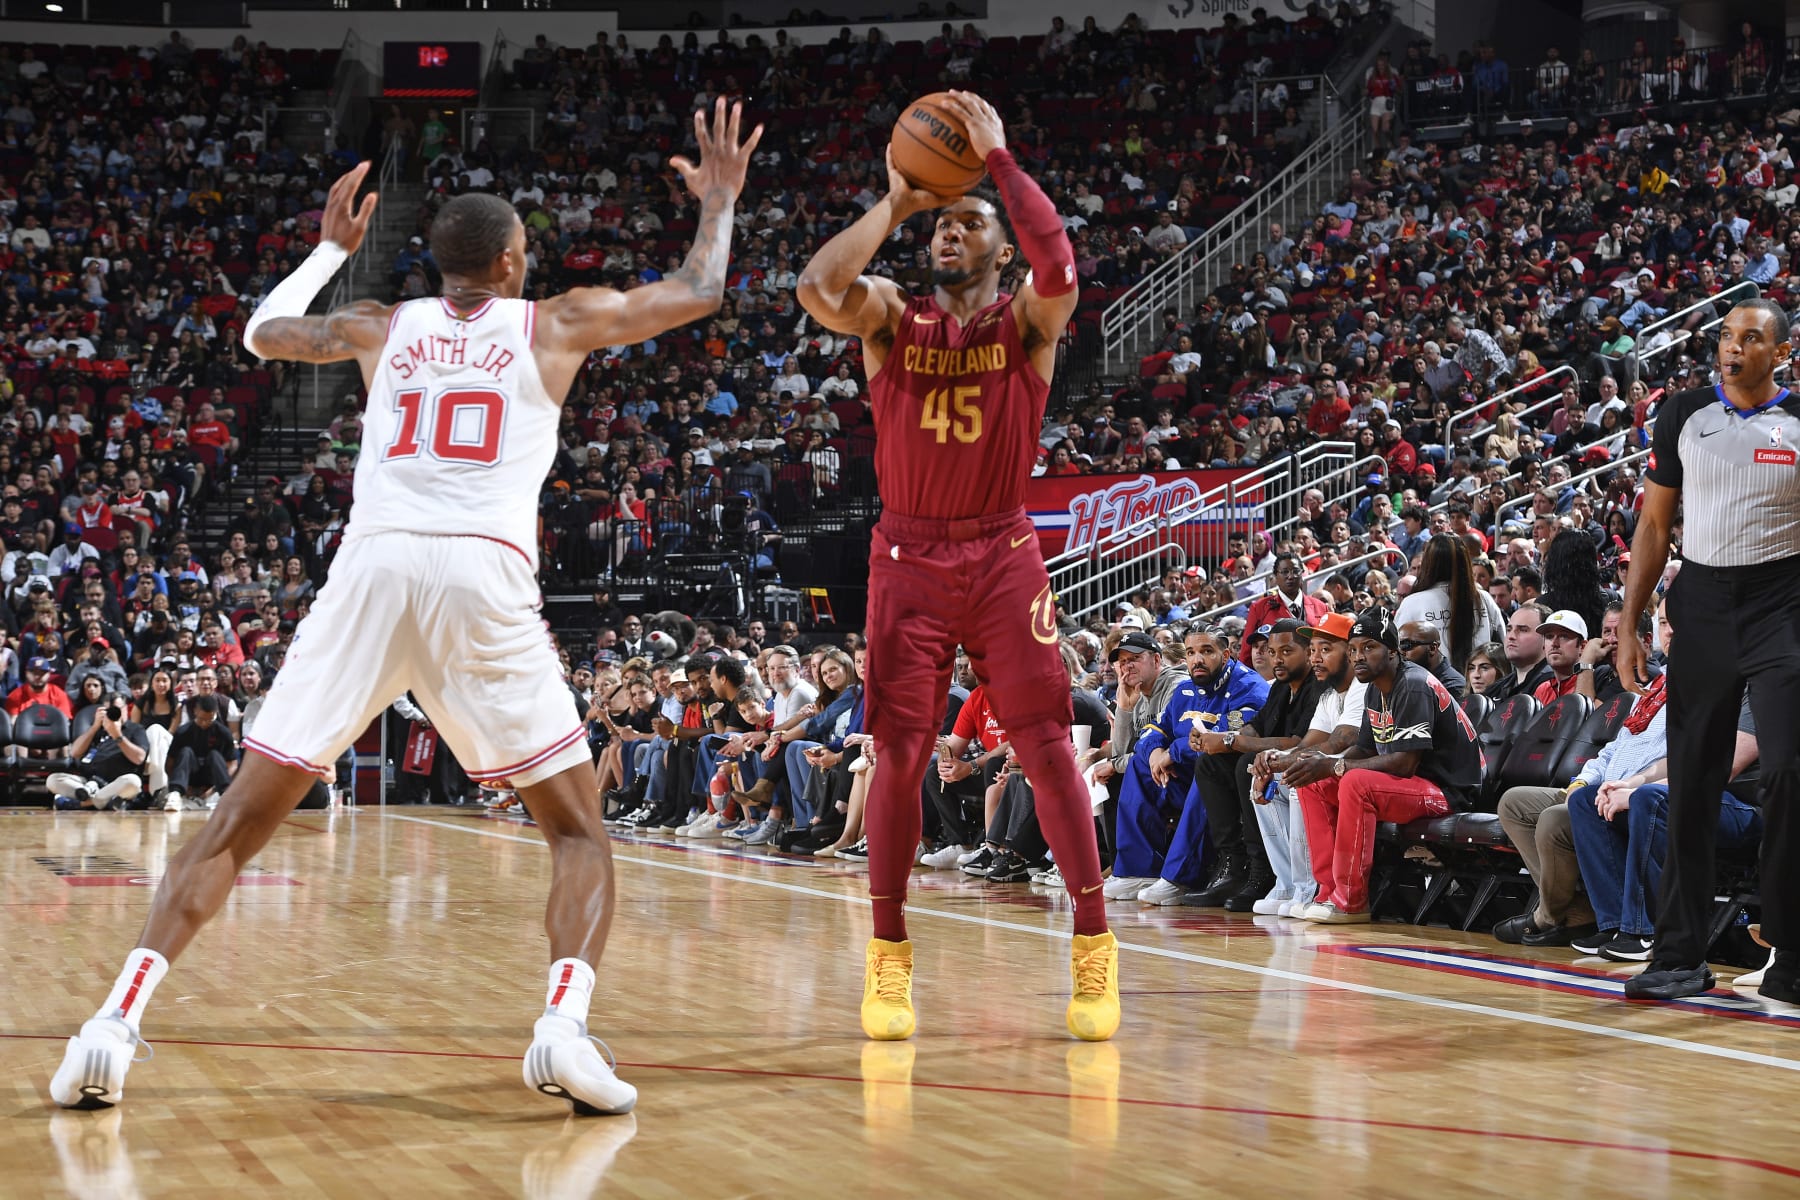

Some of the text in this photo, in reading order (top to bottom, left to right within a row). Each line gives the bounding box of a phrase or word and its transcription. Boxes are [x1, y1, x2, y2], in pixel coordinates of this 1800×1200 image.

[390, 335, 467, 380] SMITH
[904, 343, 1006, 376] CLEVELAND
[381, 387, 509, 468] 10
[920, 385, 983, 444] 45
[1757, 451, 1792, 461] Emirates
